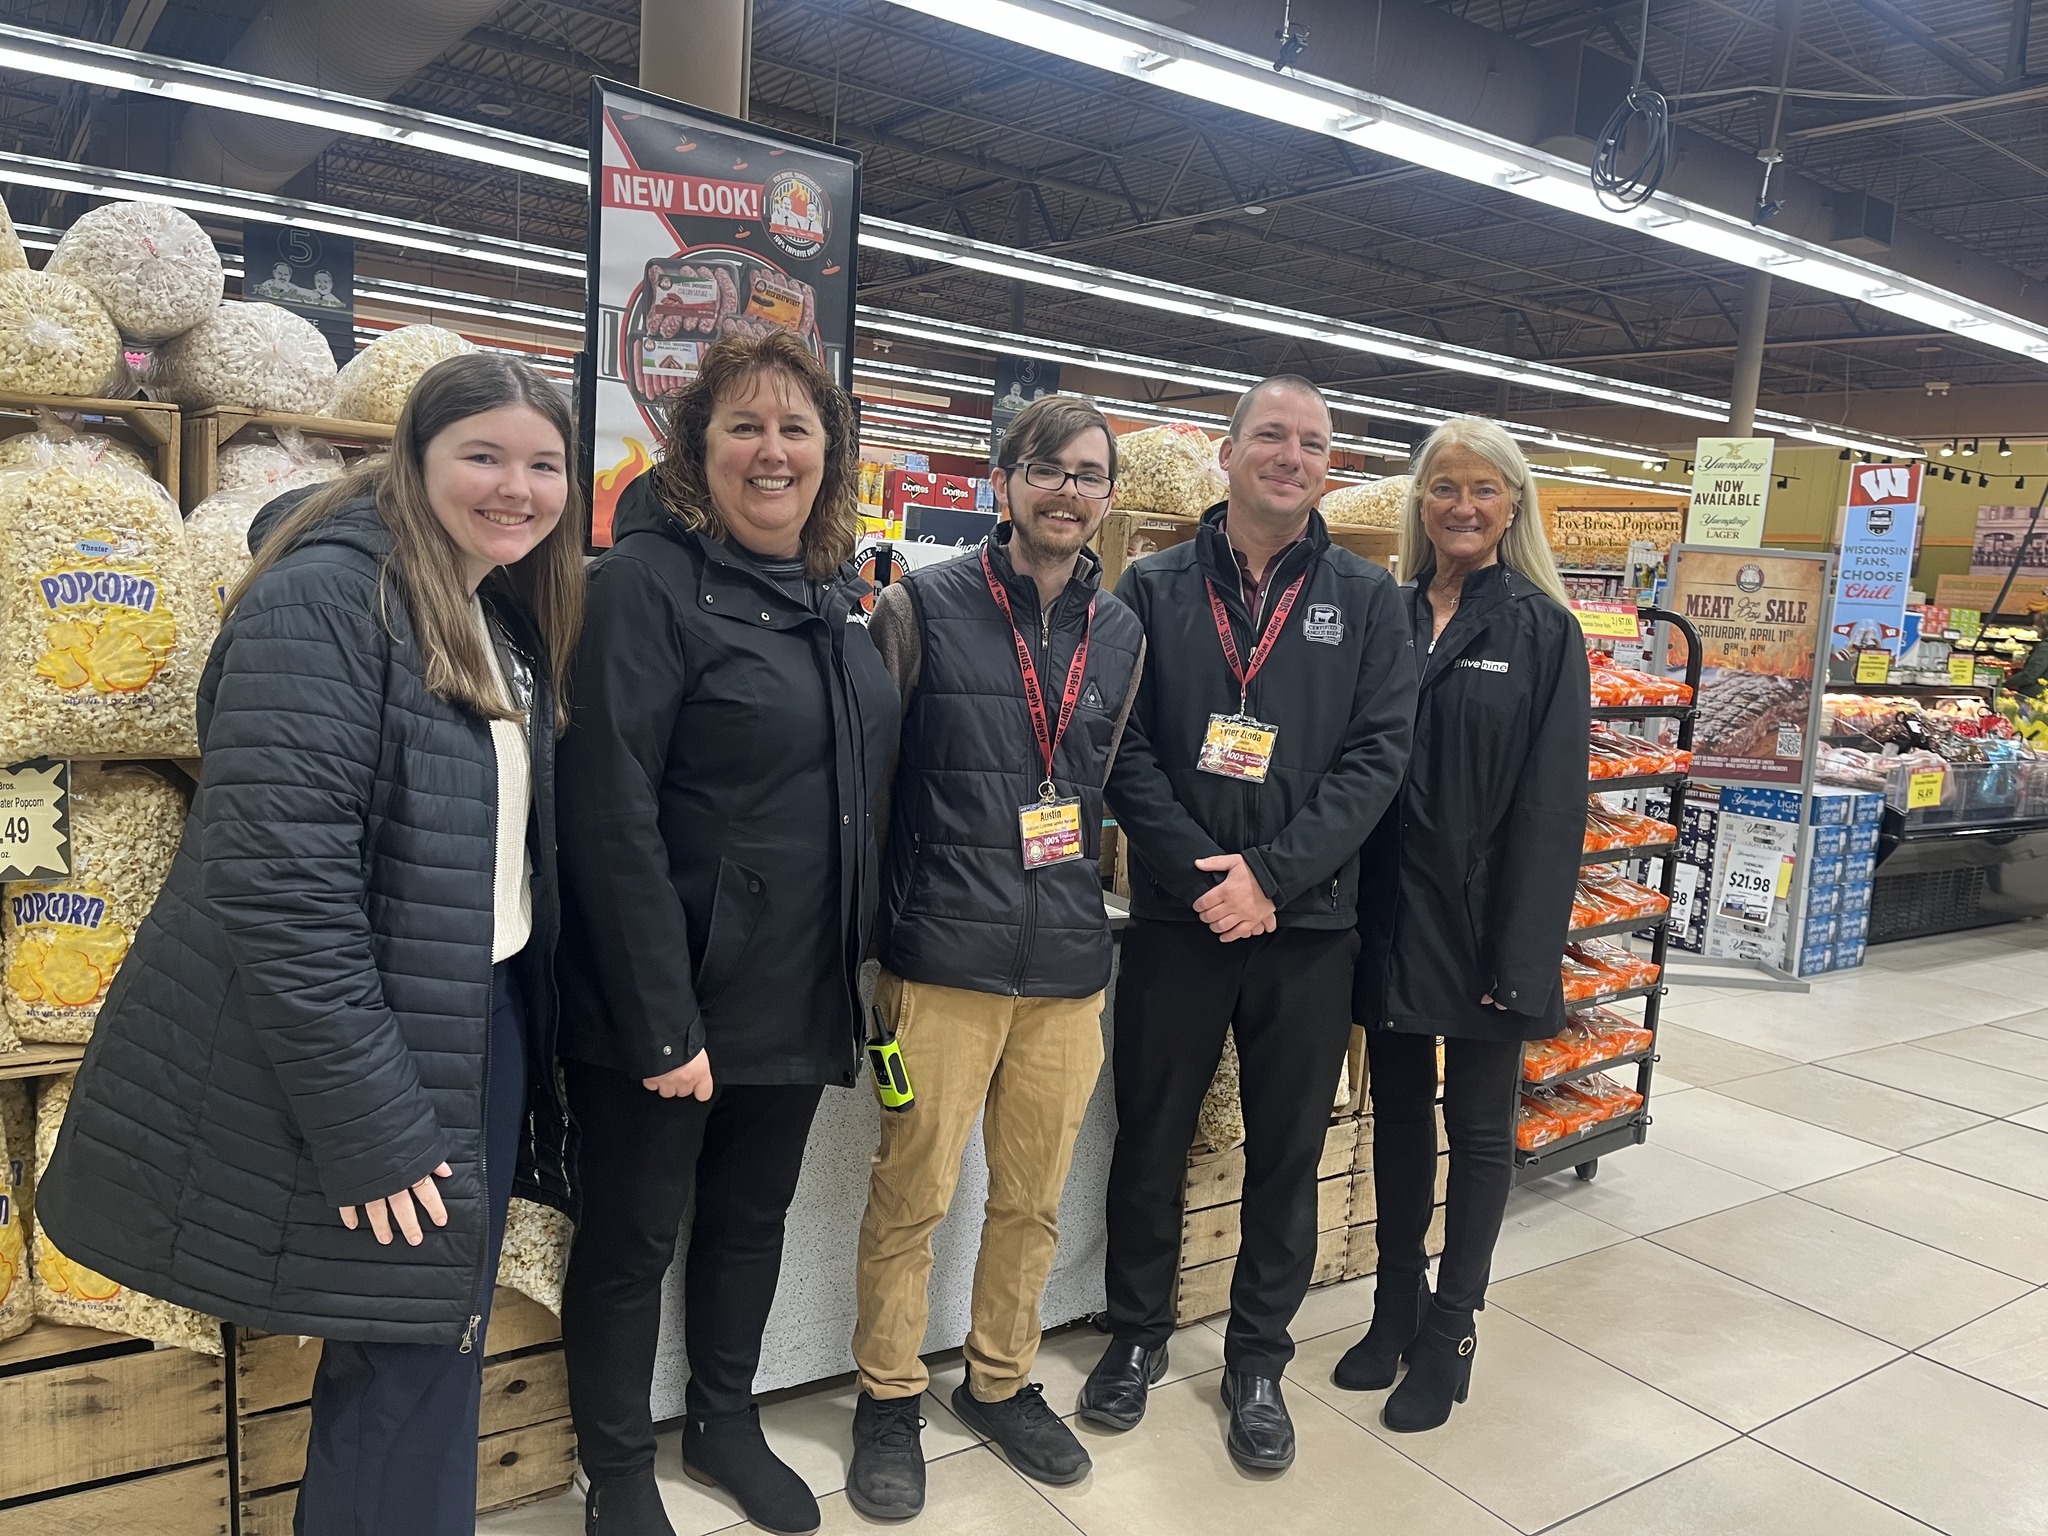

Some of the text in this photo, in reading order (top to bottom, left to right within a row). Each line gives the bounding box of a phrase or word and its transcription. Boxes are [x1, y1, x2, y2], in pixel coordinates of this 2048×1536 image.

[612, 173, 759, 217] NEW LOOK!
[289, 228, 313, 263] 5
[1021, 357, 1035, 383] 3
[1698, 455, 1768, 473] Yuengling
[902, 482, 929, 495] Doritos
[942, 486, 969, 499] Doritos
[1714, 480, 1744, 493] NOW
[1860, 467, 1910, 503] W
[1694, 492, 1762, 507] AVAILABLE
[1558, 515, 1679, 535] Fox Bros. Popcorn
[1706, 530, 1740, 540] LAGER
[81, 543, 109, 553] Theater
[1844, 545, 1909, 556] WISCONSIN
[854, 549, 873, 569] FINE
[1855, 557, 1890, 568] FANS,
[1841, 570, 1904, 582] CHOOSE
[40, 571, 156, 613] POPCORN
[1845, 583, 1896, 600] Chill
[1685, 594, 1808, 624] MEAT SALE
[1253, 592, 1295, 670] BROS. piggly wiggly
[1698, 624, 1747, 642] SATURDAY,
[1750, 628, 1776, 643] APRIL
[1220, 628, 1234, 653] BROS.
[1228, 652, 1239, 668] FOX
[1741, 647, 1749, 657] TO
[1067, 665, 1083, 695] piggly
[1018, 645, 1047, 744] BROS. piggly wiggly
[1227, 751, 1245, 761] 100%
[0, 797, 45, 811] ater Popcorn
[1700, 791, 1721, 800] BREWERY
[1731, 793, 1776, 810] Yuengling
[1040, 810, 1062, 822] Austin
[1044, 836, 1060, 846] 100%
[0, 851, 11, 859] oz.
[1729, 871, 1771, 893] $21.98
[12, 892, 105, 929] POPCORN
